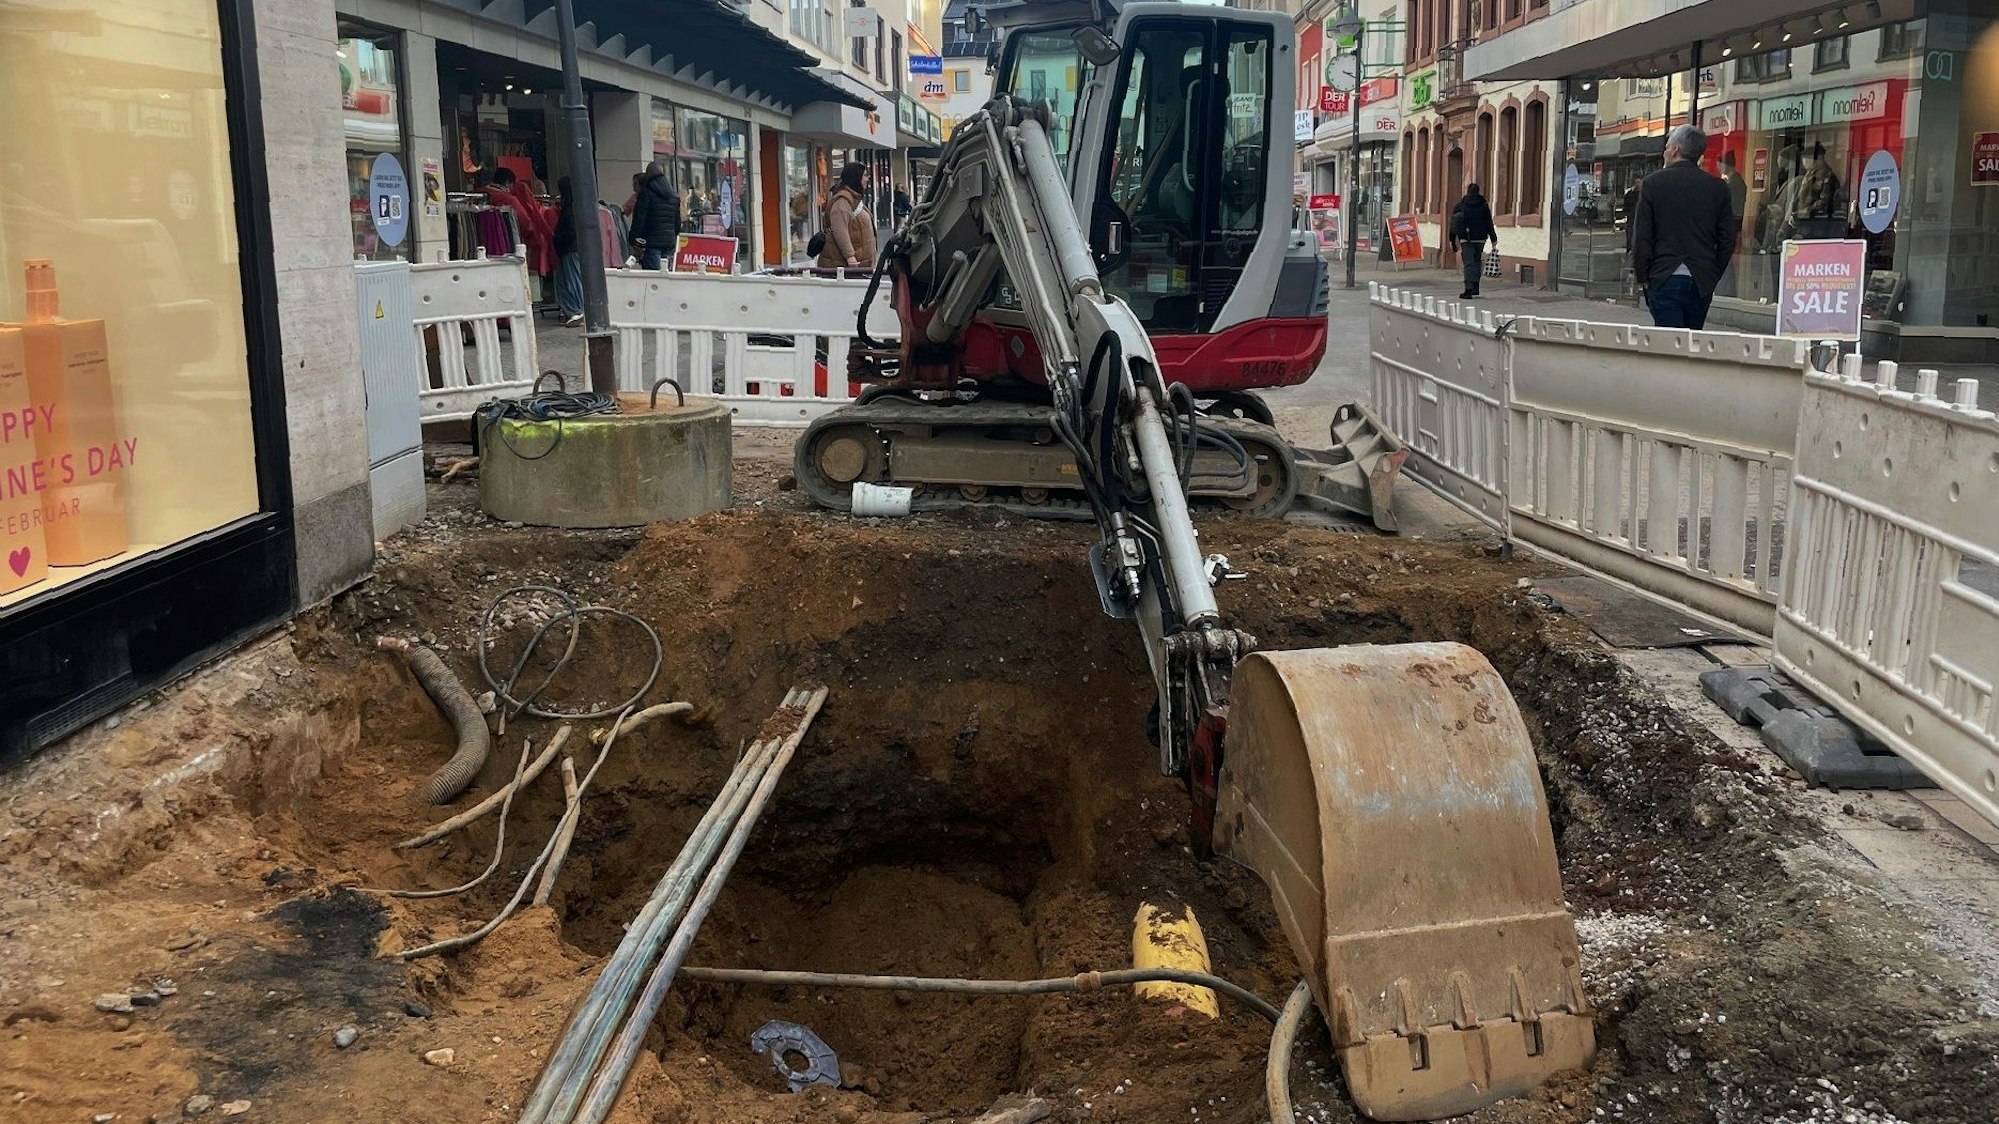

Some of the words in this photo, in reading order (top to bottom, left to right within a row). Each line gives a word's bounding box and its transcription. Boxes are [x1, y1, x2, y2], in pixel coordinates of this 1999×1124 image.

[924, 81, 943, 93] dm
[1325, 91, 1345, 102] DER
[1324, 102, 1345, 110] TOUR
[1377, 121, 1396, 131] DER
[683, 253, 725, 268] MARKEN
[1794, 263, 1850, 277] MARKEN
[1791, 291, 1849, 314] SALE
[1242, 362, 1286, 377] 84476
[2, 403, 56, 444] PPY
[88, 437, 138, 476] DAY
